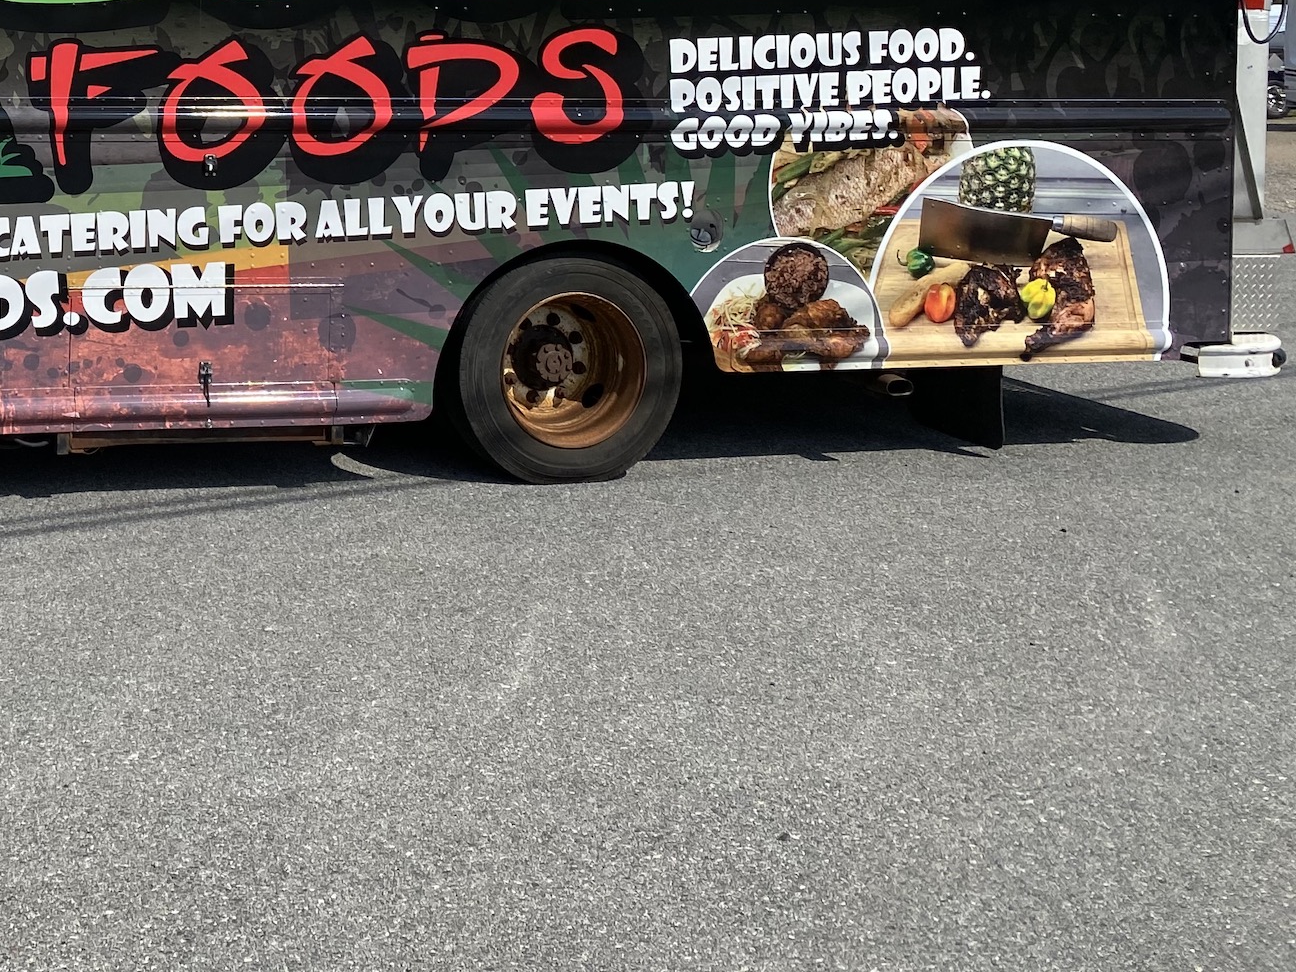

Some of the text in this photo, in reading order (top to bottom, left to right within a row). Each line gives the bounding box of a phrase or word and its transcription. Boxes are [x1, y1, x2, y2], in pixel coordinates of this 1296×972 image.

[669, 28, 975, 73] DELICIOUS FOOD.
[30, 28, 624, 166] FOODS
[669, 66, 991, 113] POSITIVE PEOPLE.
[670, 108, 898, 150] GOOD VIBES.
[218, 202, 307, 243] FOR
[525, 181, 695, 227] EVENTS!
